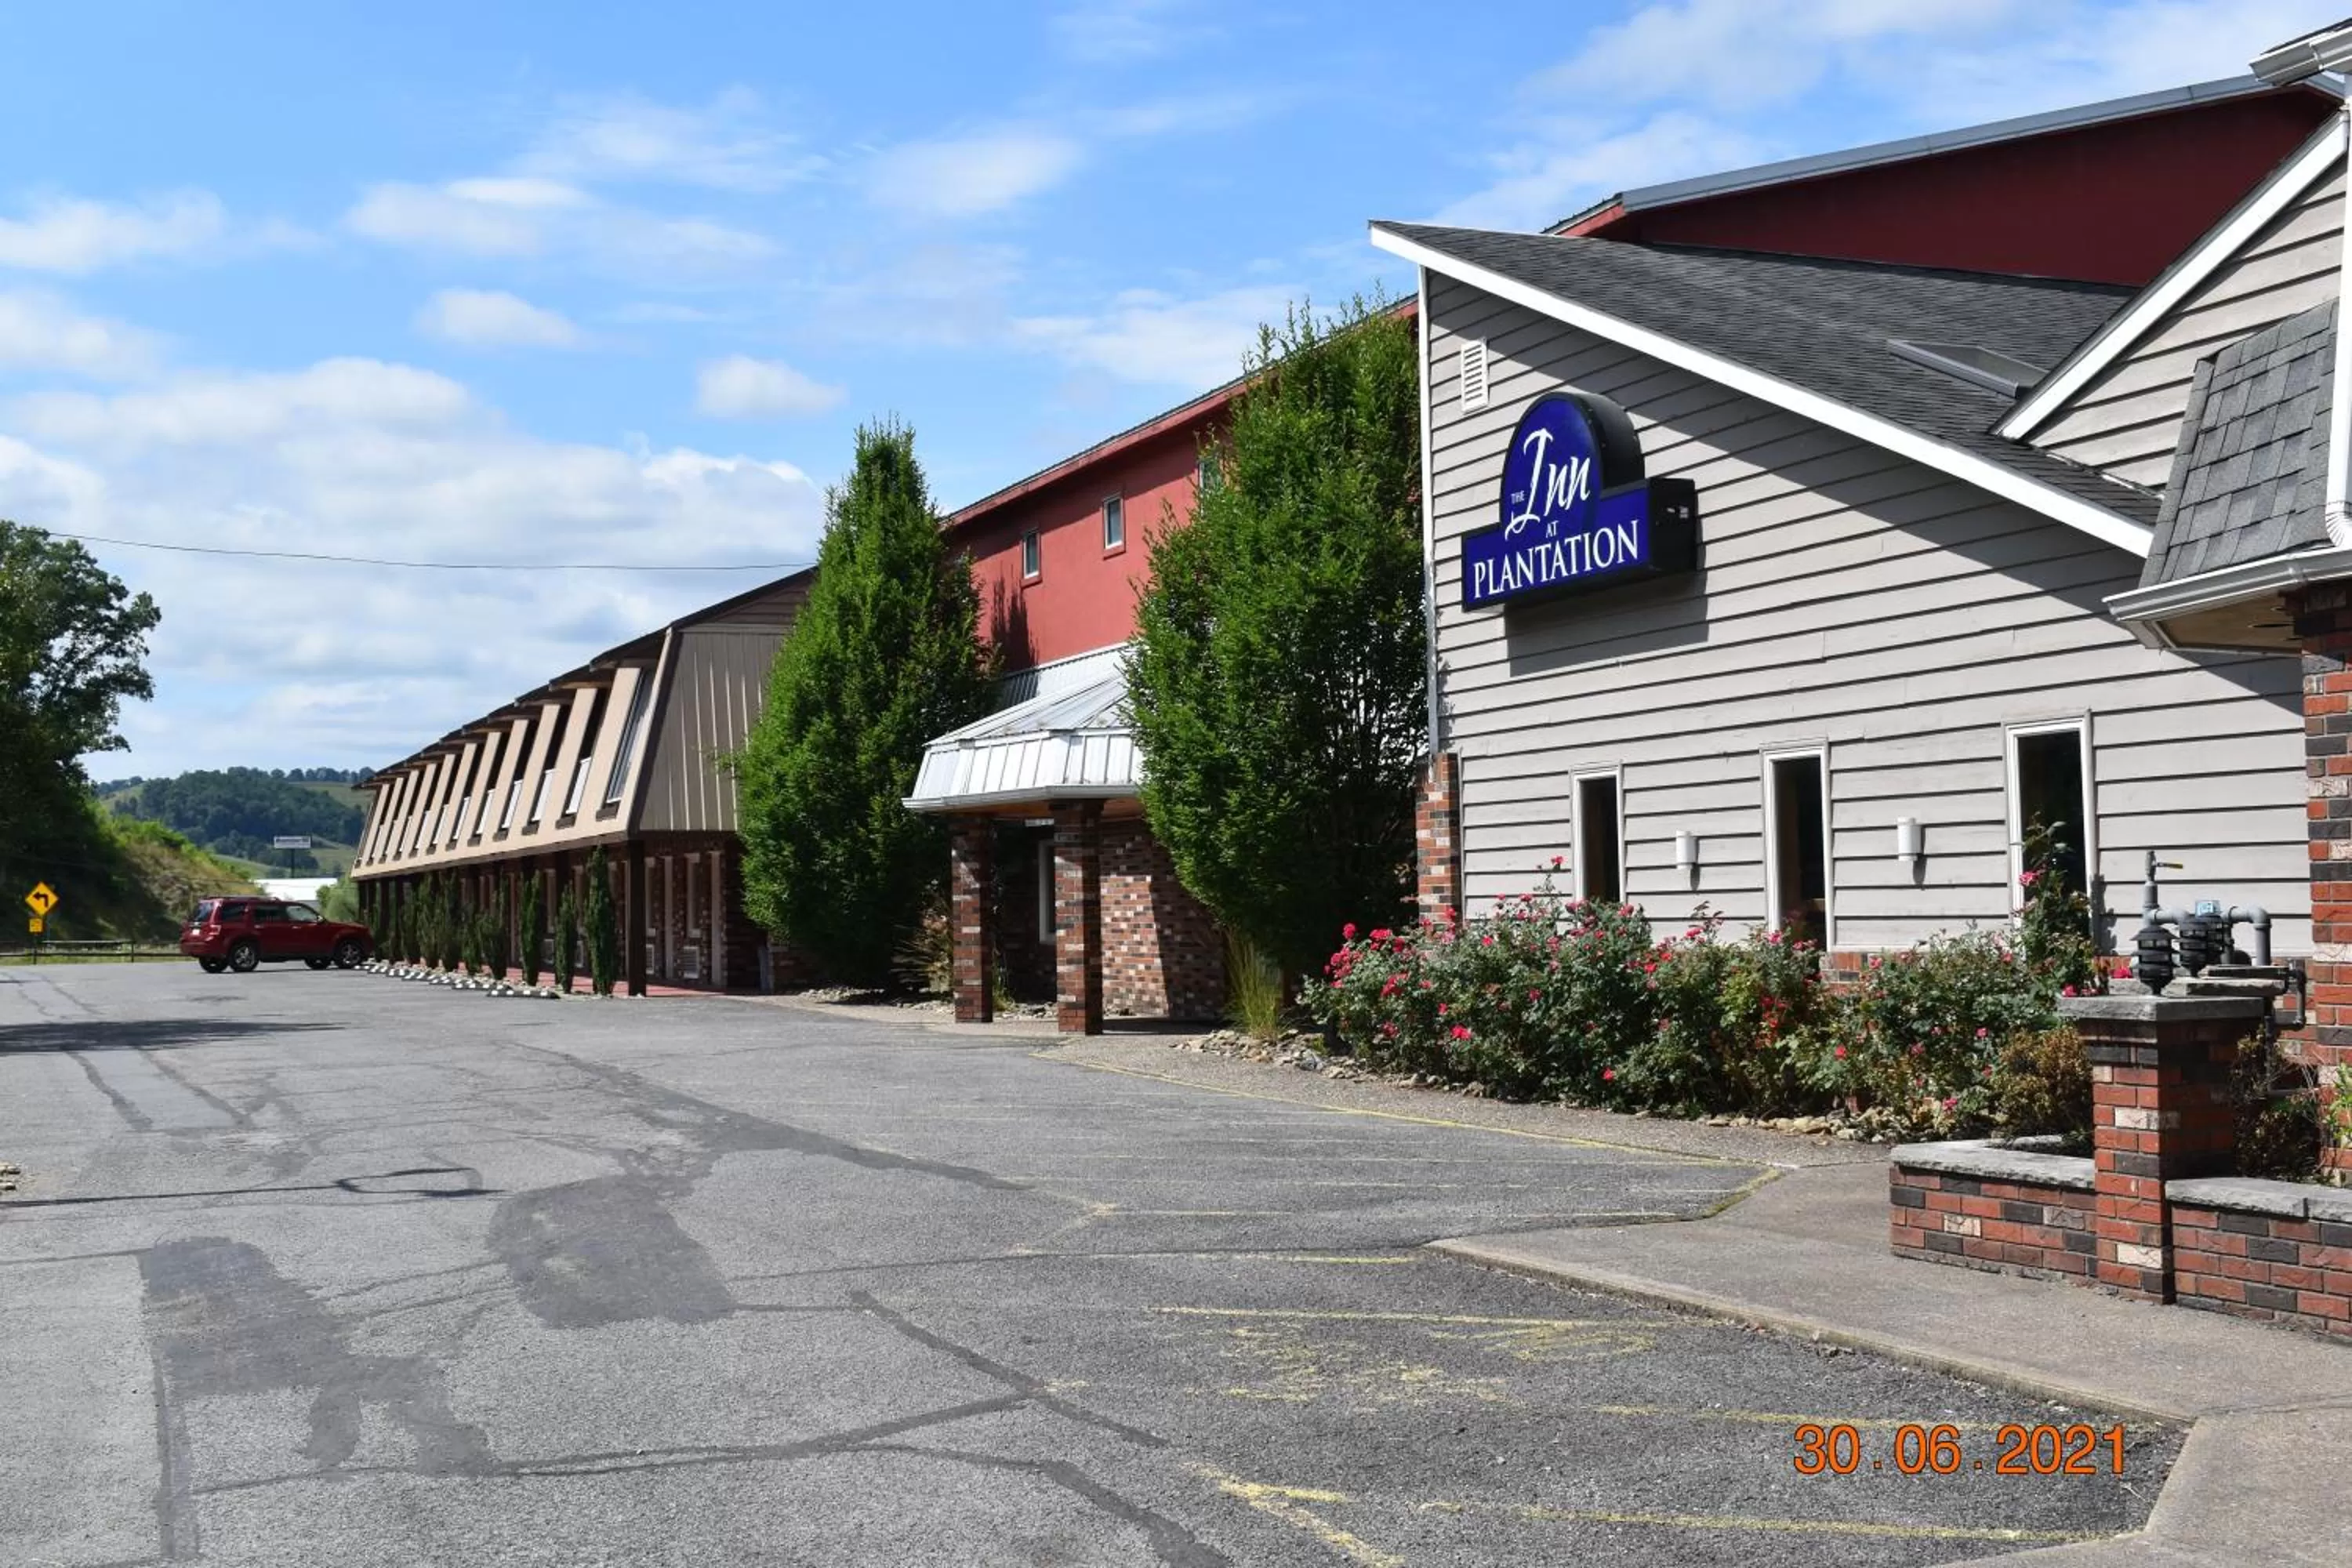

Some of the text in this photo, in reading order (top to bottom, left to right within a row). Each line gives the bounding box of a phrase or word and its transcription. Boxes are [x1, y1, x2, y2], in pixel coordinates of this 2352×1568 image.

[1504, 428, 1591, 541] THE Inn
[1472, 519, 1639, 599] PLANTATION
[1545, 520, 1559, 538] AT
